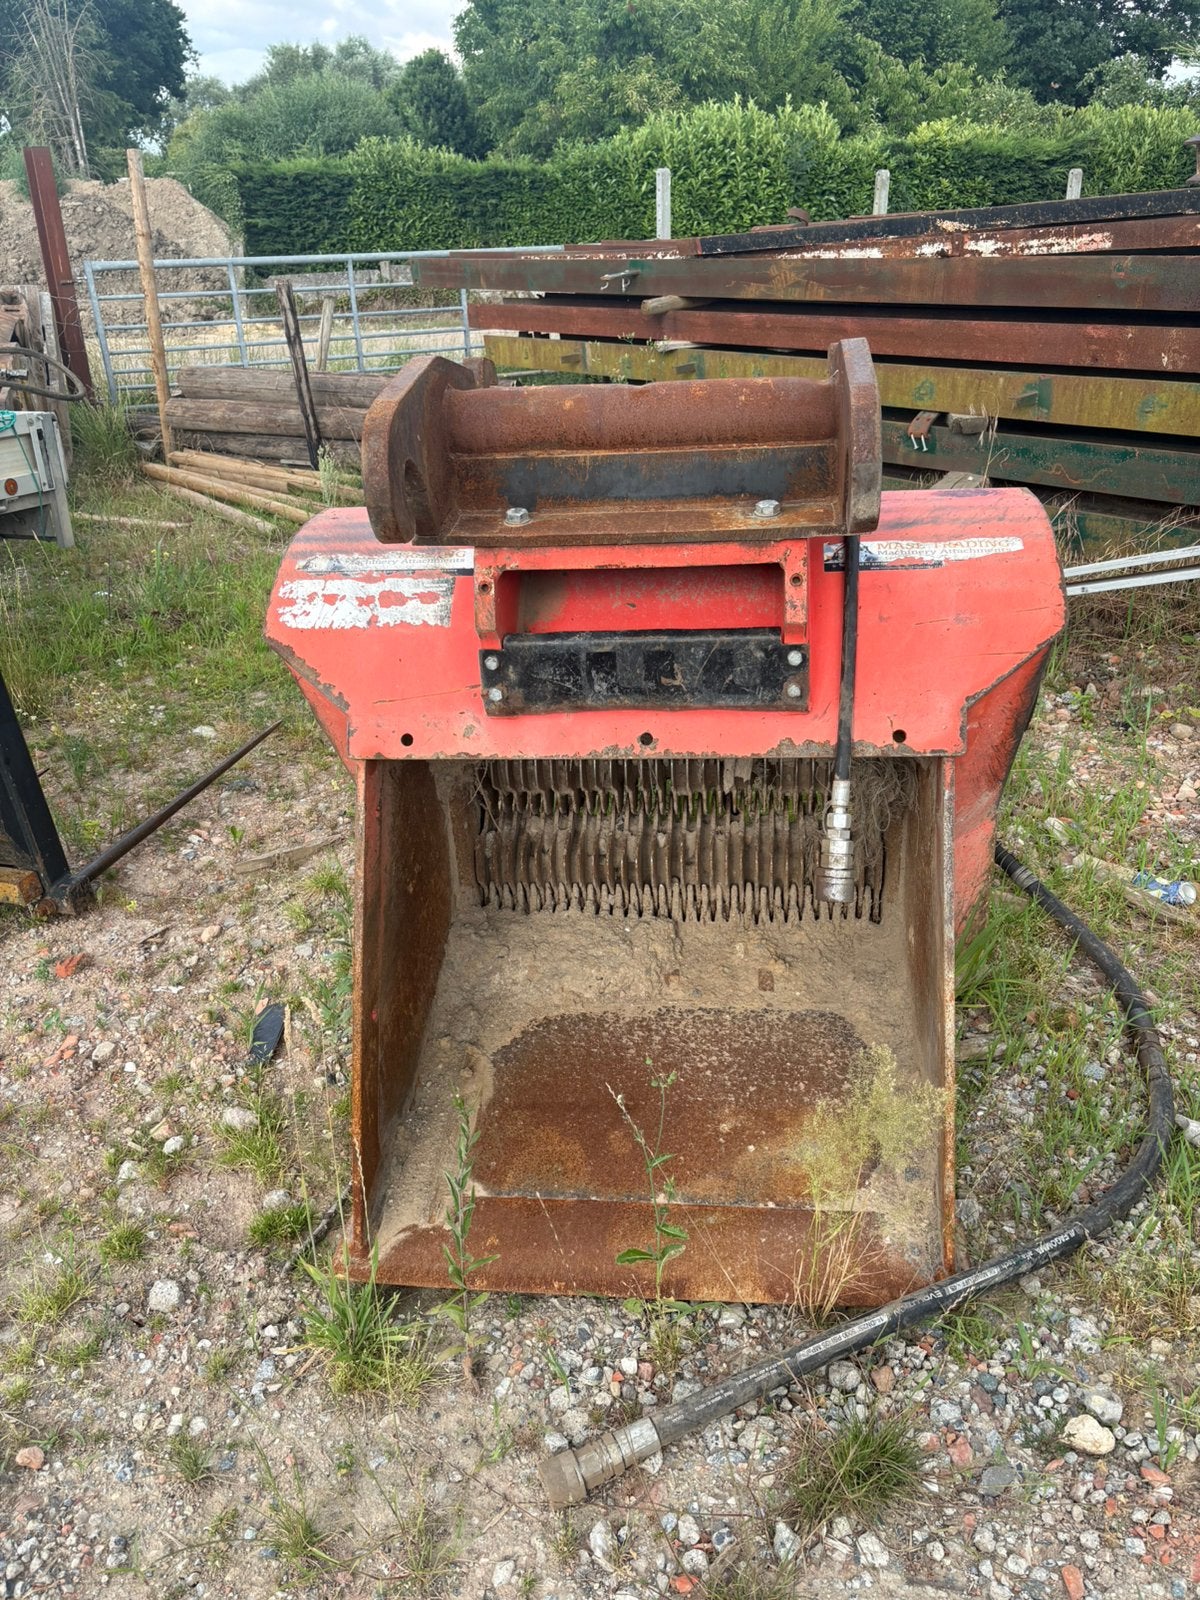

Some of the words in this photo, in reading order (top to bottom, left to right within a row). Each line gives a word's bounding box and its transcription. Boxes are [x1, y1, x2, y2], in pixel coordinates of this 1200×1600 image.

[877, 542, 926, 550] MASE
[932, 540, 1010, 551] TRADING
[877, 549, 937, 557] Machinery
[941, 547, 1012, 555] Attachments
